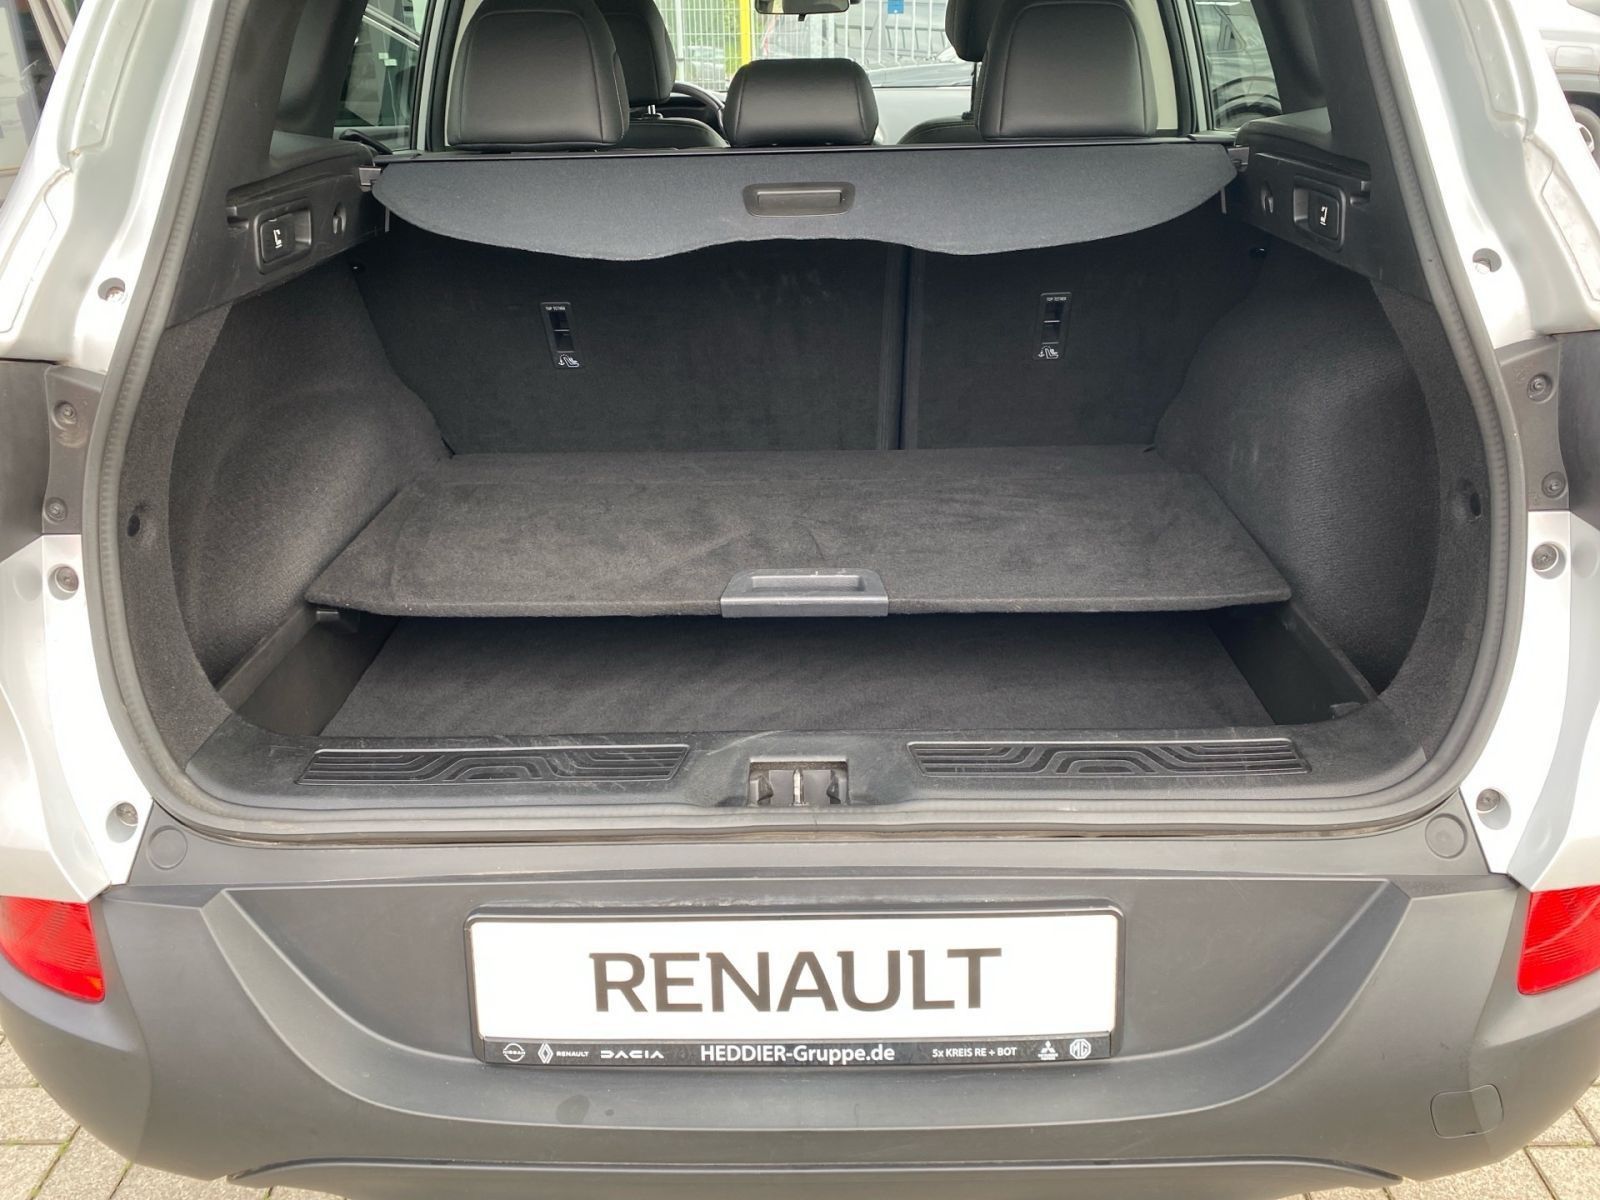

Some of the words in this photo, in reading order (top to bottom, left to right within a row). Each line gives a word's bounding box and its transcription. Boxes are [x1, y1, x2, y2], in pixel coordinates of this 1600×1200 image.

[589, 948, 1002, 1012] RENAULT
[556, 1050, 589, 1058] RENAULT
[600, 1050, 665, 1059] DACIA
[700, 1043, 896, 1066] HEDDIER-Gruppe.de
[931, 1048, 945, 1058] 5x
[945, 1048, 974, 1058] KREIS
[974, 1047, 987, 1057] RE
[997, 1046, 1018, 1057] BOT
